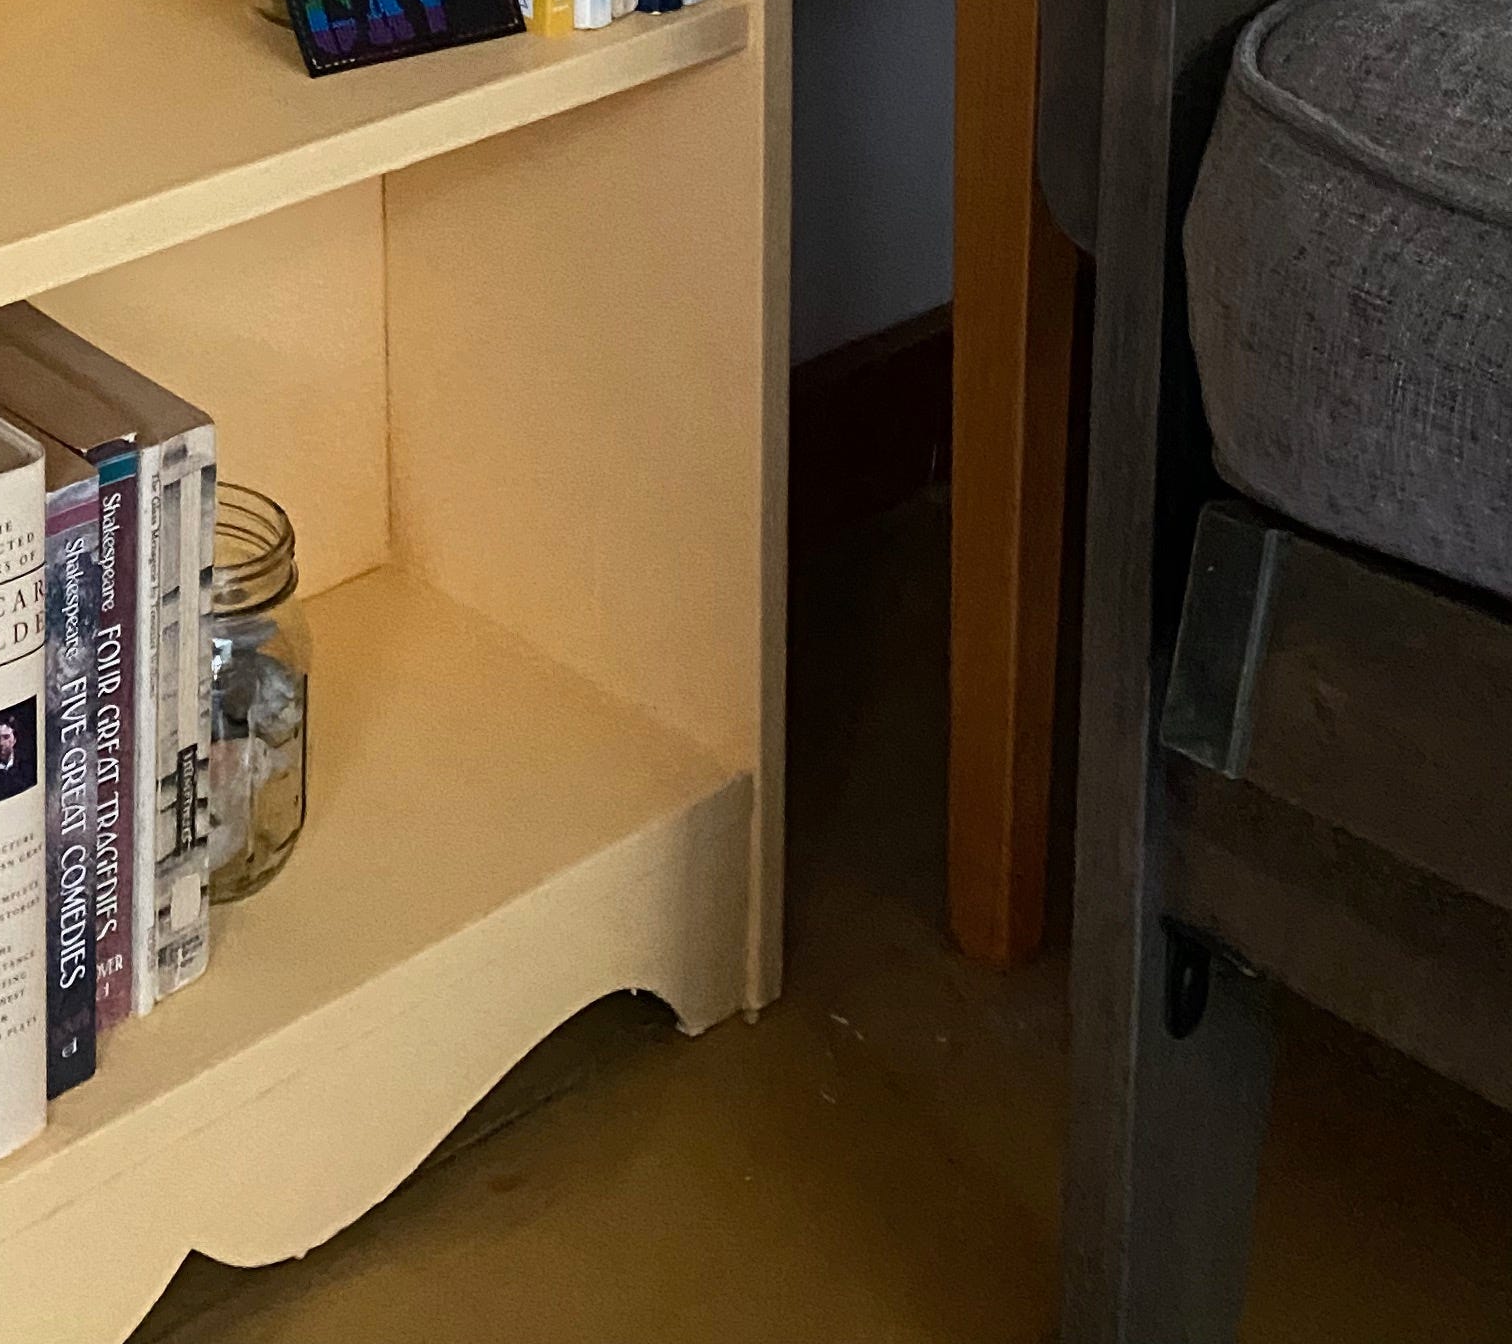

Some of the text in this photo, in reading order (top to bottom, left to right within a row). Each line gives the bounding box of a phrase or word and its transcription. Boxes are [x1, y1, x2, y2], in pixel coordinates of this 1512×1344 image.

[58, 538, 86, 989] Shakespeare FIVE GREAT COMEDIES
